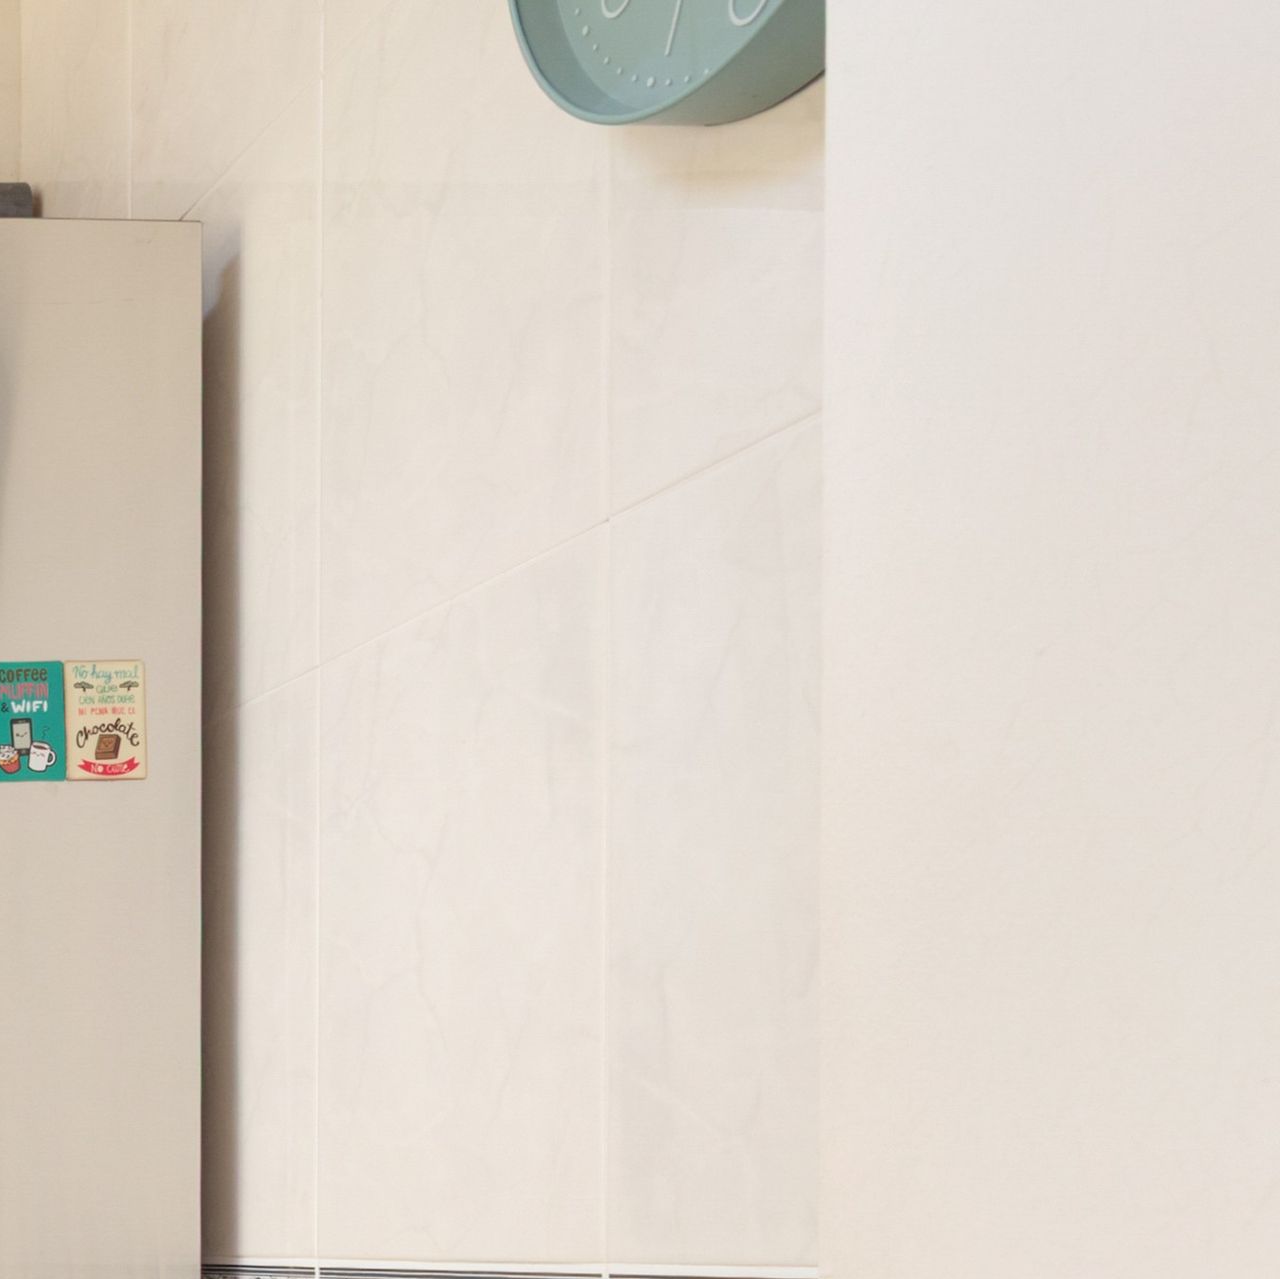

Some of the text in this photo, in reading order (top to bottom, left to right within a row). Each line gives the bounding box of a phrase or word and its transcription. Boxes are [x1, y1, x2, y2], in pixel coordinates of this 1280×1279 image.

[90, 664, 112, 684] hay
[114, 665, 139, 679] mal
[1, 699, 48, 713] & WIFI
[76, 718, 140, 749] Chocolate
